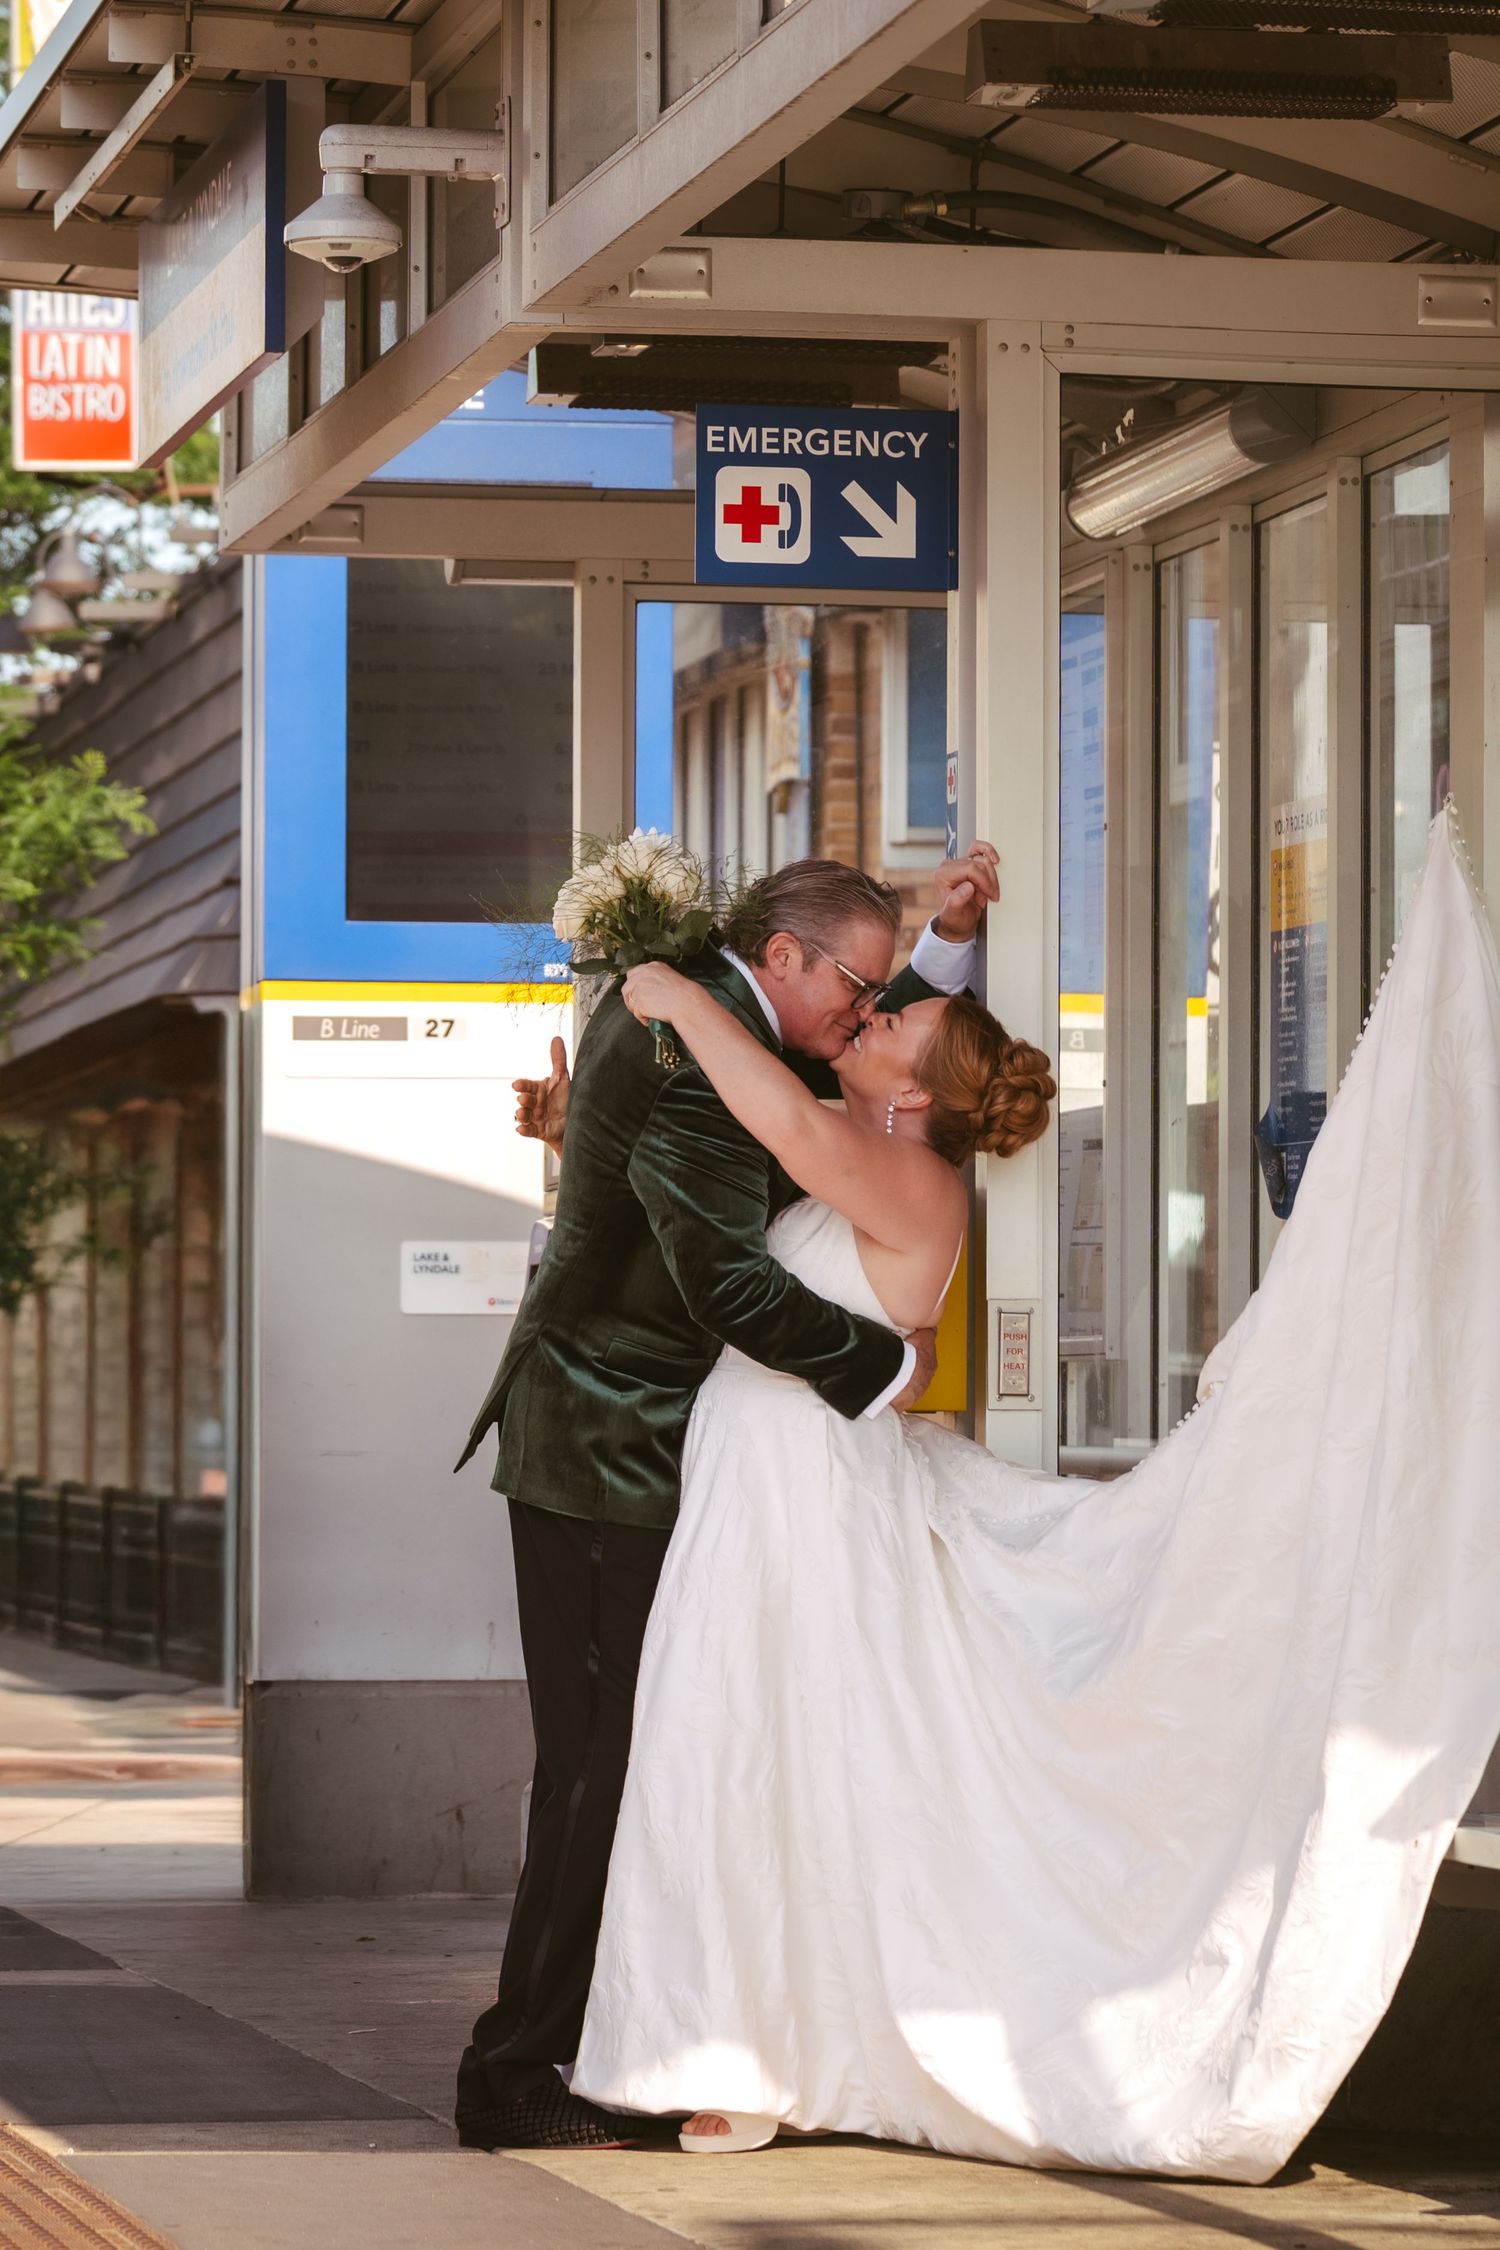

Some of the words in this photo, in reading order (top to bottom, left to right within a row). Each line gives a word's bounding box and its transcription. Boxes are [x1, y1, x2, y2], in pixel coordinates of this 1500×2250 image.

[29, 332, 121, 380] LATIN
[28, 382, 126, 422] BISTRO
[706, 425, 929, 459] EMERGENCY
[1289, 813, 1304, 832] ROLE
[320, 1018, 335, 1039] B
[341, 1018, 380, 1039] Line
[425, 1019, 455, 1038] 27
[413, 1252, 439, 1262] LAKE
[443, 1252, 449, 1262] &
[413, 1264, 461, 1274] LYNDALE
[1003, 1332, 1027, 1341] PUSH
[1006, 1347, 1024, 1356] FOR
[1003, 1362, 1026, 1371] HEAT
